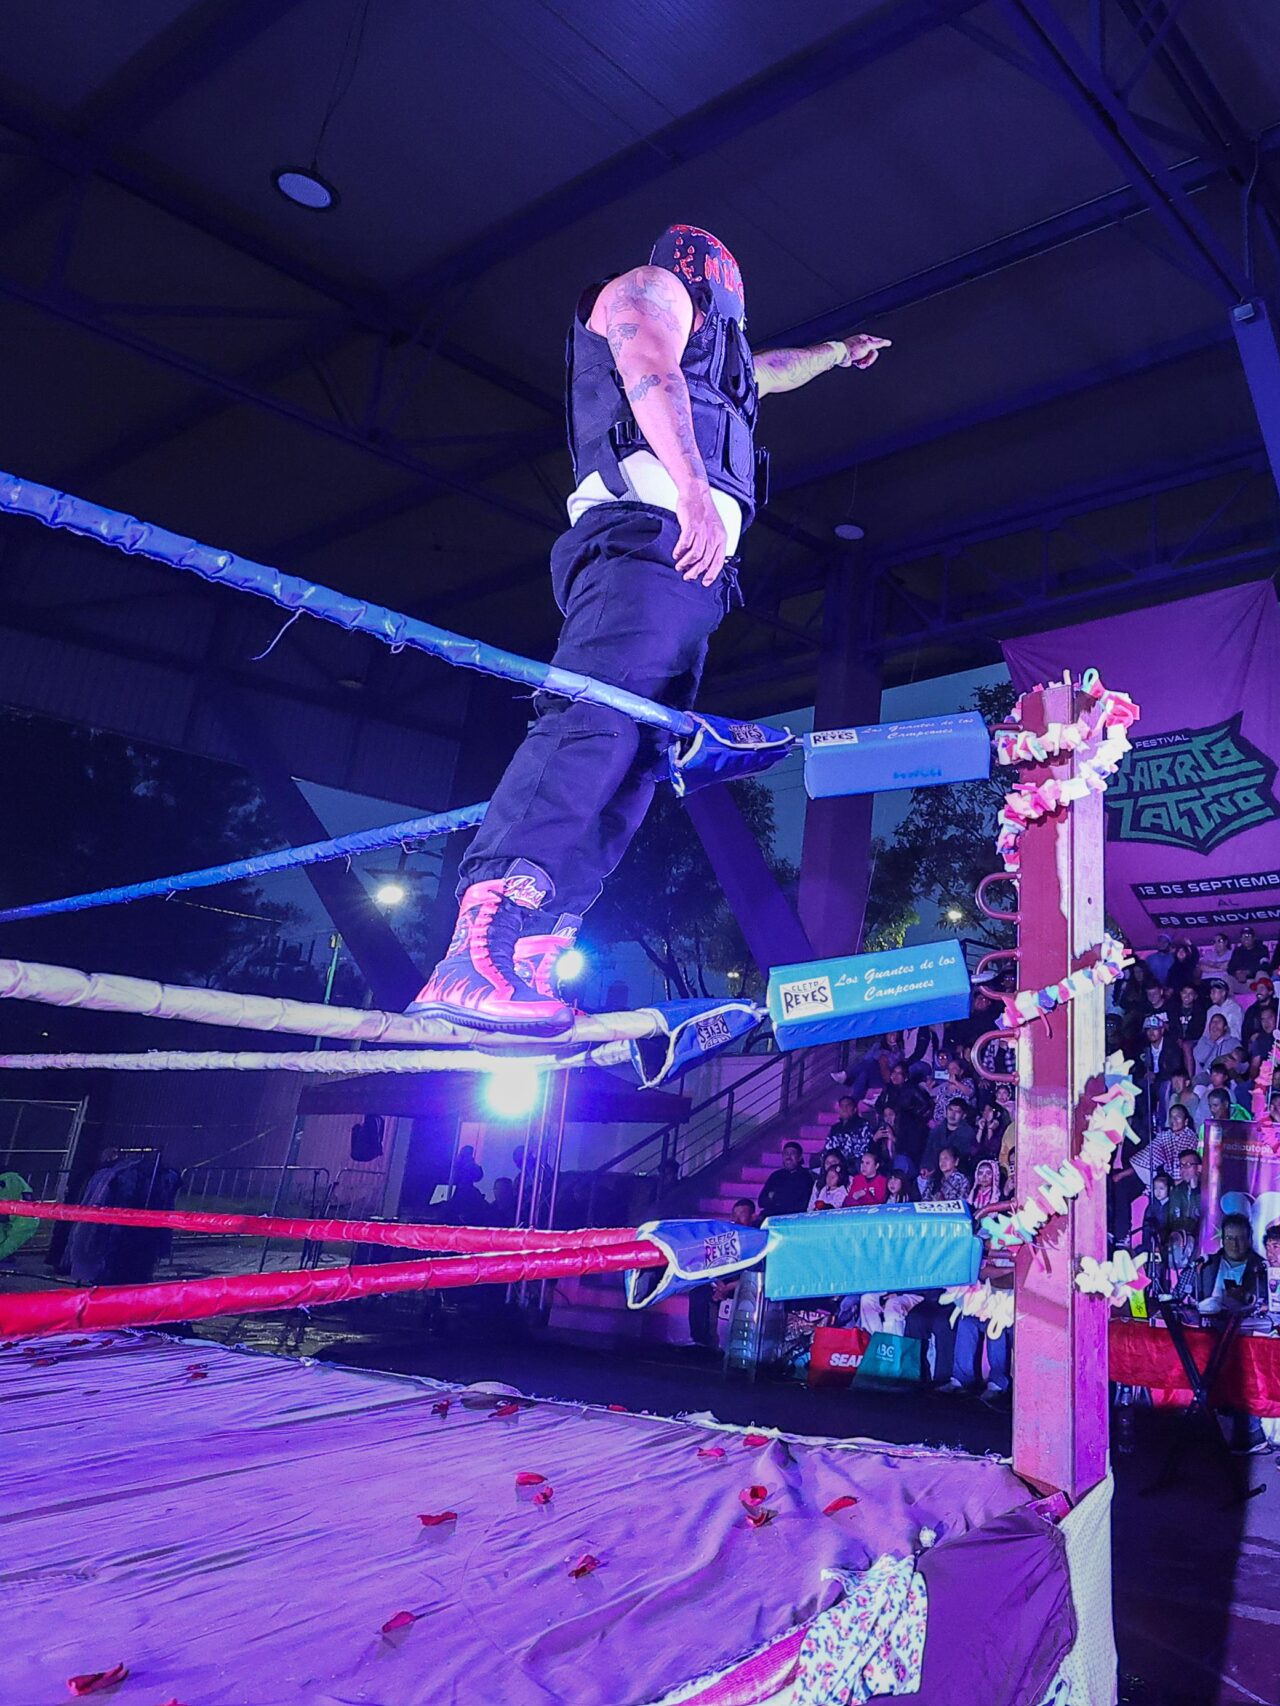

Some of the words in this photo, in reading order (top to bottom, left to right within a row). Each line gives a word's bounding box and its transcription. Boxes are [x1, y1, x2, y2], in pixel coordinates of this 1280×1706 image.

[813, 732, 854, 745] REYES
[1135, 734, 1190, 749] FESTIVAL
[1105, 774, 1274, 848] LATINO
[1138, 886, 1157, 896] 12
[1161, 884, 1184, 895] DE
[1217, 898, 1240, 907] AL
[1186, 916, 1208, 925] DE
[834, 974, 858, 987] Los
[864, 964, 914, 984] Guantes
[920, 959, 934, 970] de
[938, 955, 956, 966] los
[792, 981, 819, 992] CLETO
[864, 978, 935, 1001] Campeones
[784, 986, 829, 1013] REYES
[698, 1016, 729, 1043] REYES
[918, 1201, 961, 1210] REYES
[709, 1232, 732, 1243] CLETO
[705, 1238, 738, 1267] REYES
